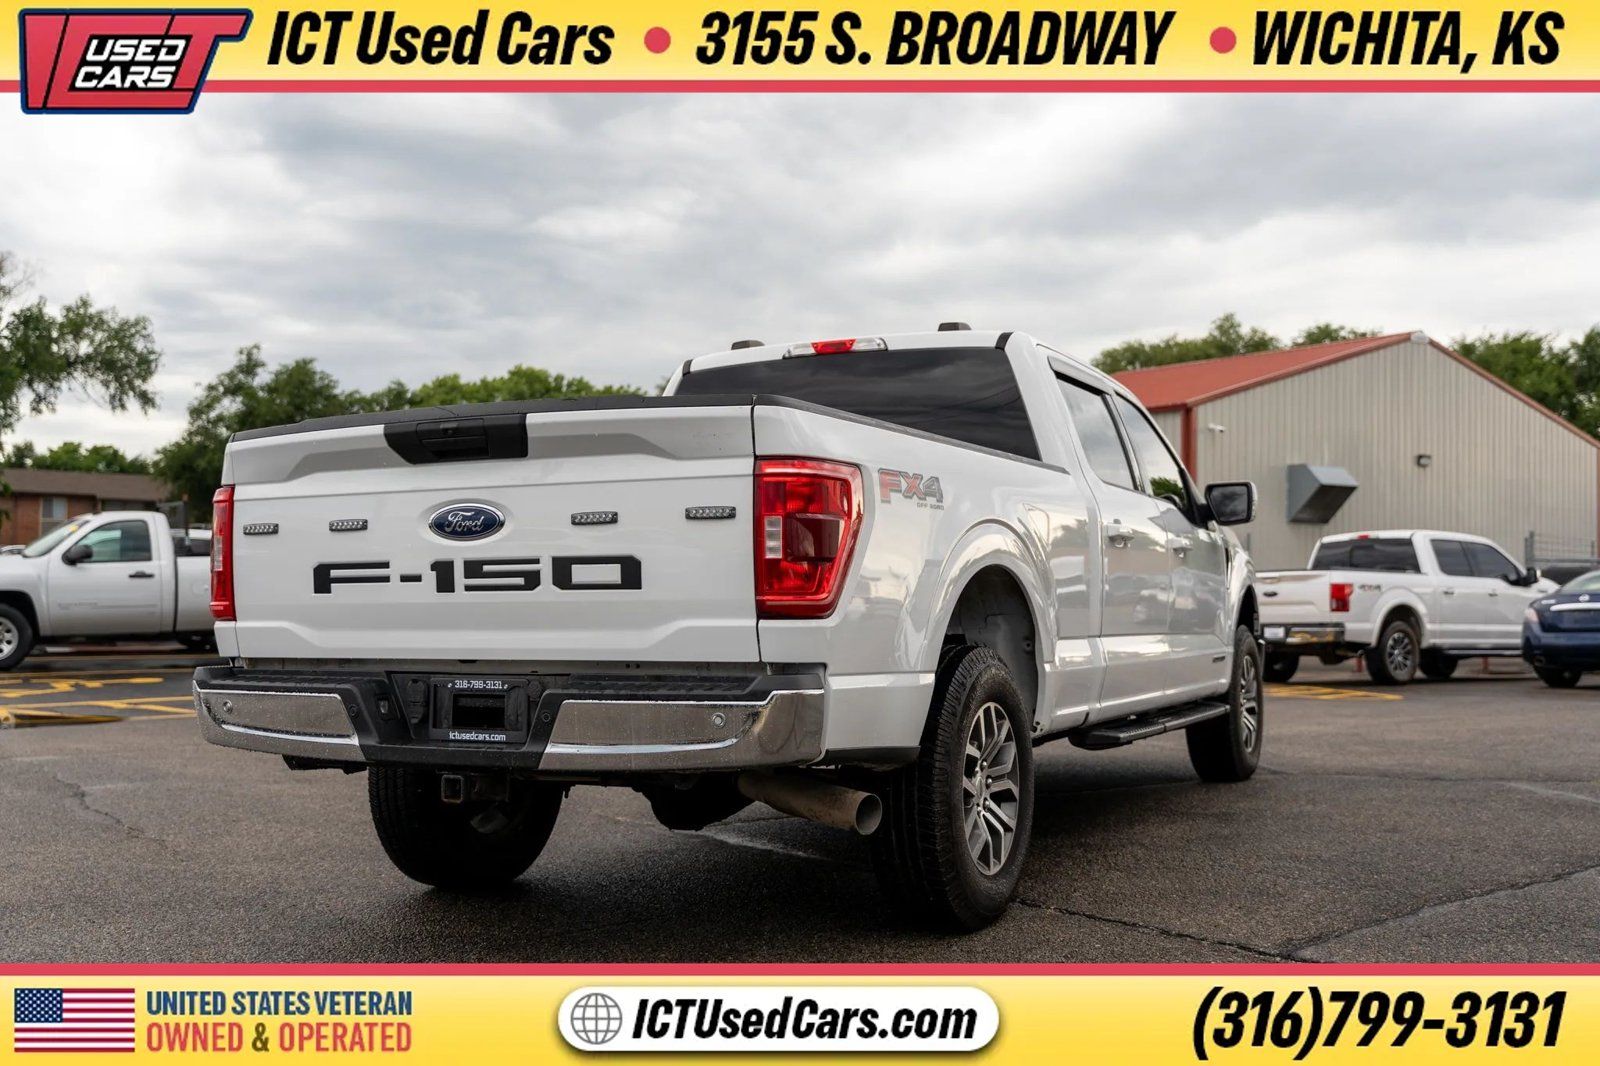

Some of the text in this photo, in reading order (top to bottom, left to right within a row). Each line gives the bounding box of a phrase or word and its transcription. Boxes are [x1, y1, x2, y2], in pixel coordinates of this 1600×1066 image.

[877, 467, 944, 504] FX4
[444, 510, 486, 533] Ford
[312, 554, 643, 595] F-150
